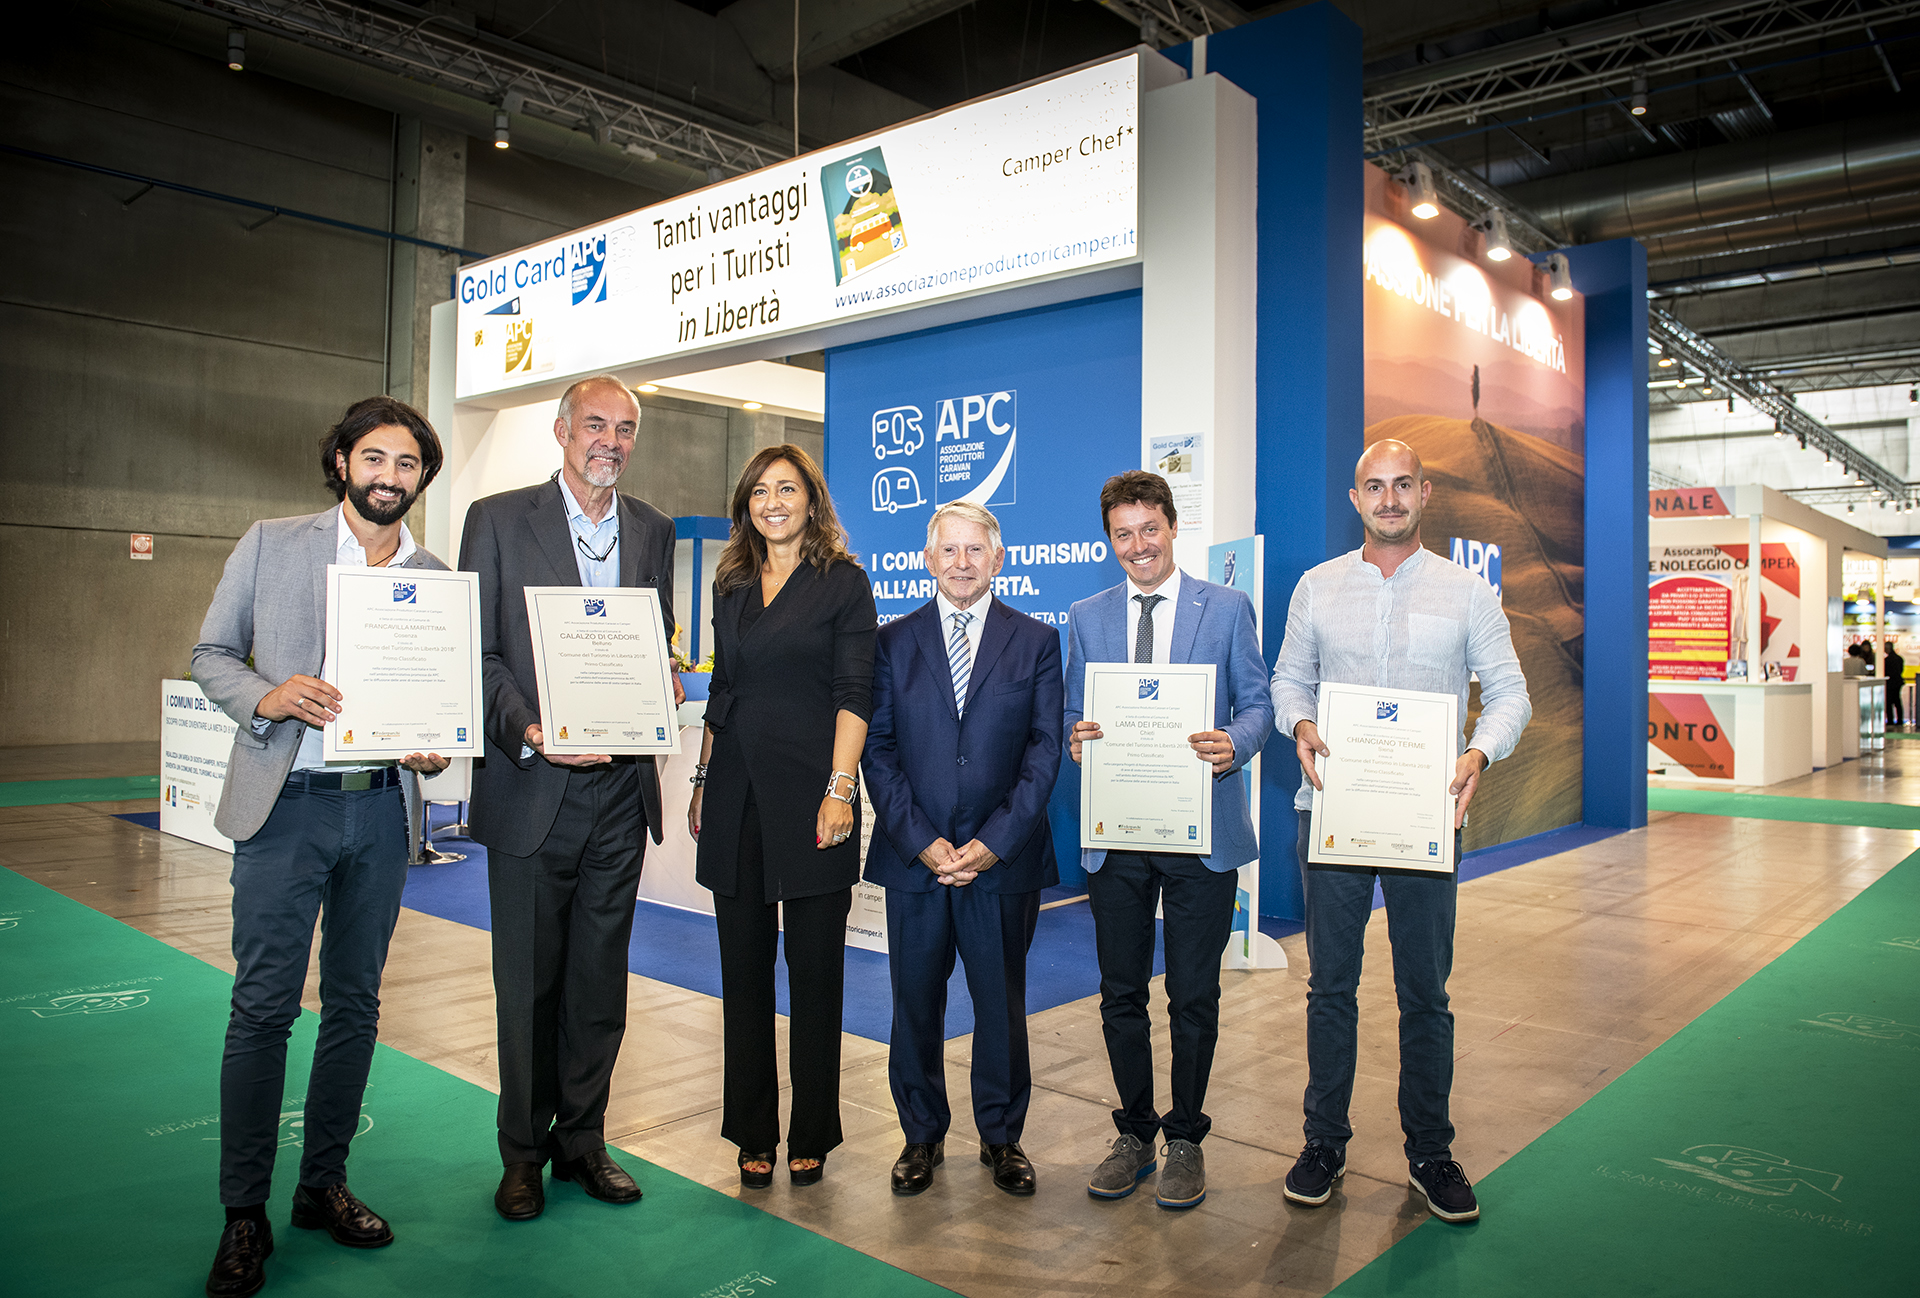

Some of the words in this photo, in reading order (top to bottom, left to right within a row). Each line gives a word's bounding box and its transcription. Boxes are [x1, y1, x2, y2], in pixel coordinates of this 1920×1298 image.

[1003, 146, 1072, 176] Camper
[653, 206, 701, 249] Tanti
[709, 172, 807, 233] vantaggi
[571, 234, 606, 268] APC
[671, 265, 703, 304] per
[711, 253, 715, 285] i
[723, 232, 790, 281] Turisti
[835, 228, 1135, 308] www.associazioneproduttoricamper.it
[461, 265, 506, 304] Gold
[515, 247, 565, 288] Card
[678, 311, 696, 342] in
[704, 289, 780, 337] Libertà
[506, 318, 532, 343] APC
[1491, 305, 1511, 346] LA
[936, 391, 1011, 442] APC
[940, 442, 985, 455] ASSOCIAZIONE
[1152, 442, 1168, 450] Gold
[1168, 440, 1184, 448] Card
[939, 451, 985, 464] PRODUTTORI
[940, 463, 971, 473] CARAVAN
[940, 474, 944, 483] E
[944, 472, 971, 482] CAMPER
[872, 553, 876, 572] I
[882, 551, 925, 571] COM
[1007, 541, 1107, 566] TURISMO
[1664, 546, 1722, 558] Assocamp
[1660, 558, 1731, 571] NOLEGGIO
[393, 583, 415, 592] APC
[990, 576, 1040, 596] ERTA.
[584, 599, 604, 607] APC
[364, 623, 409, 631] FRANCAVILLA
[559, 632, 597, 640] CALALZO
[1138, 679, 1158, 688] APC
[170, 695, 193, 709] COMUNI
[194, 697, 207, 711] DEL
[1377, 701, 1397, 711] APC
[1152, 721, 1182, 729] PELIGNI
[1346, 736, 1396, 747] CHIANCIANO
[1398, 740, 1426, 749] TERME
[863, 893, 883, 902] camper
[1597, 1164, 1609, 1173] IL
[1622, 1170, 1709, 1196] SALONE
[1715, 1191, 1760, 1208] DEL
[1767, 1203, 1874, 1233] CAMPER
